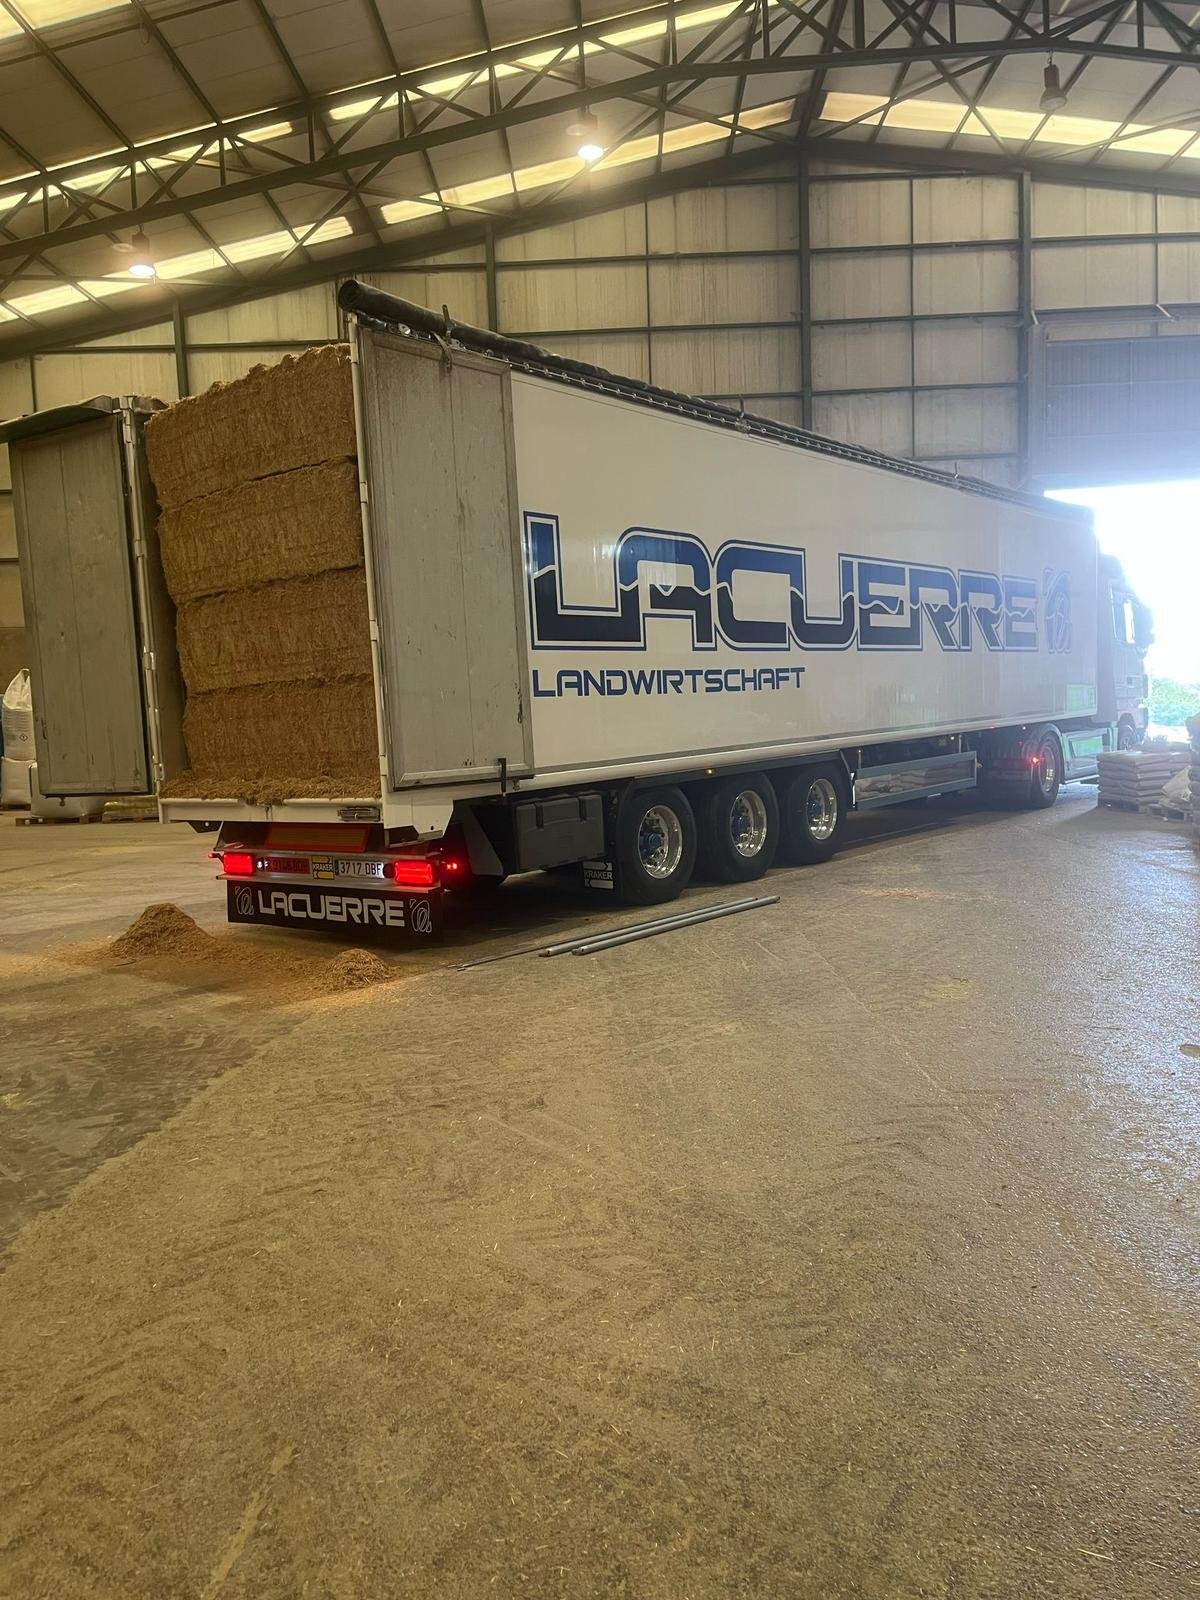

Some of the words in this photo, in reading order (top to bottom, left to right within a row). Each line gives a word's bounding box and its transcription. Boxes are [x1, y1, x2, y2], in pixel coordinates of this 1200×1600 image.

[523, 511, 1038, 651] LACUERRE
[532, 667, 805, 698] LANDWIRTSCHAFT
[312, 863, 333, 871] KRAKER
[340, 862, 362, 874] 3717
[584, 870, 613, 880] KRAKER
[259, 889, 405, 927] LACUERRE
